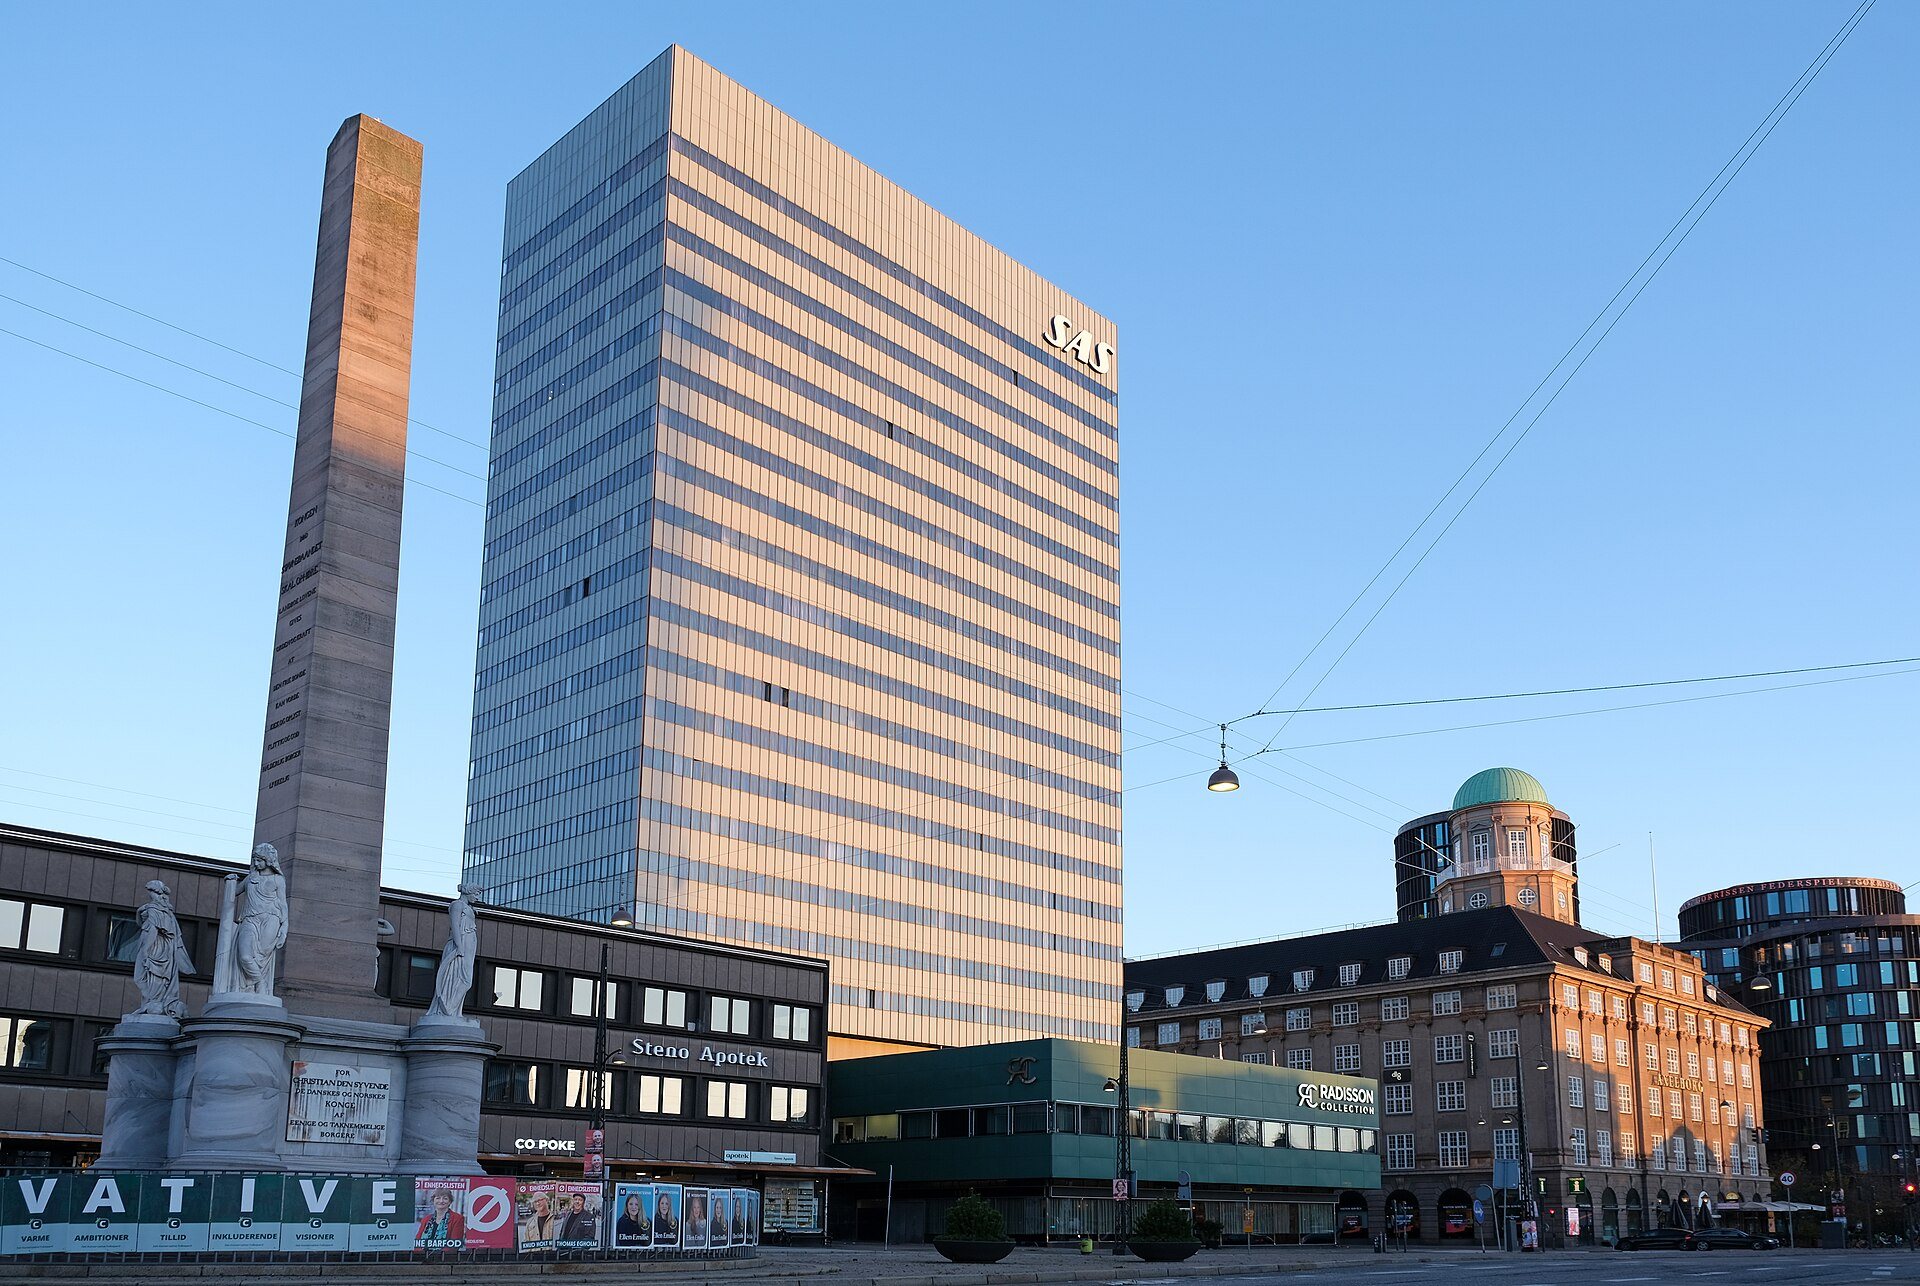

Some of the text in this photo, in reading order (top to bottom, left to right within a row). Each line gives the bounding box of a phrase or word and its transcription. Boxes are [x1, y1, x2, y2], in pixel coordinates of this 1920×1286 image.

[1042, 314, 1115, 374] SAS
[1697, 878, 1844, 904] GORRISSEN FEDERSPIEL
[632, 1038, 768, 1068] Steno Apotek
[336, 1070, 350, 1078] FOR
[293, 1078, 336, 1086] CHRISTIAN
[354, 1081, 388, 1090] SYVENDE
[1319, 1084, 1374, 1104] RADISSON
[1320, 1102, 1374, 1114] COLLECTION
[515, 1138, 576, 1151] CO POKE
